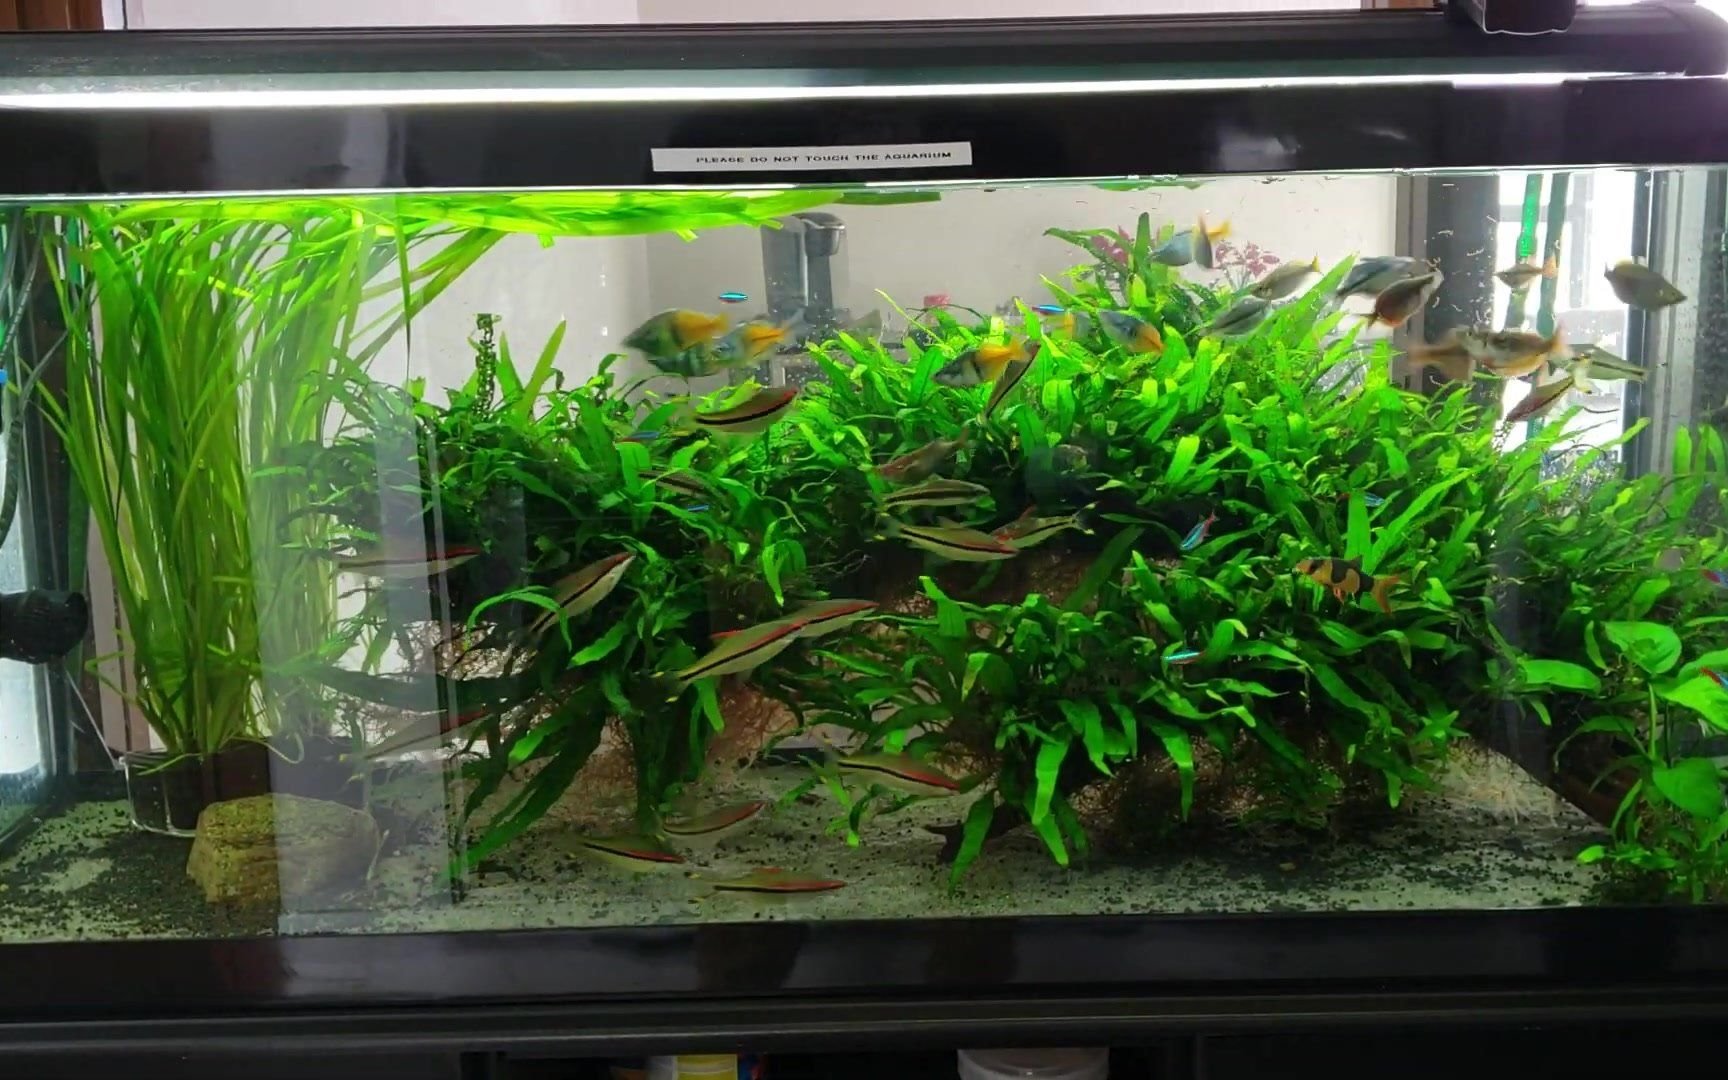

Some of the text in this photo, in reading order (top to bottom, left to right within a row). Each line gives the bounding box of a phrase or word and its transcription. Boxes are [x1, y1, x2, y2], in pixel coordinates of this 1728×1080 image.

[695, 156, 745, 164] PLEASE
[773, 155, 800, 163] NOT
[805, 154, 849, 162] TOUCH
[854, 153, 880, 161] THE
[884, 151, 952, 161] AQUARIUM
